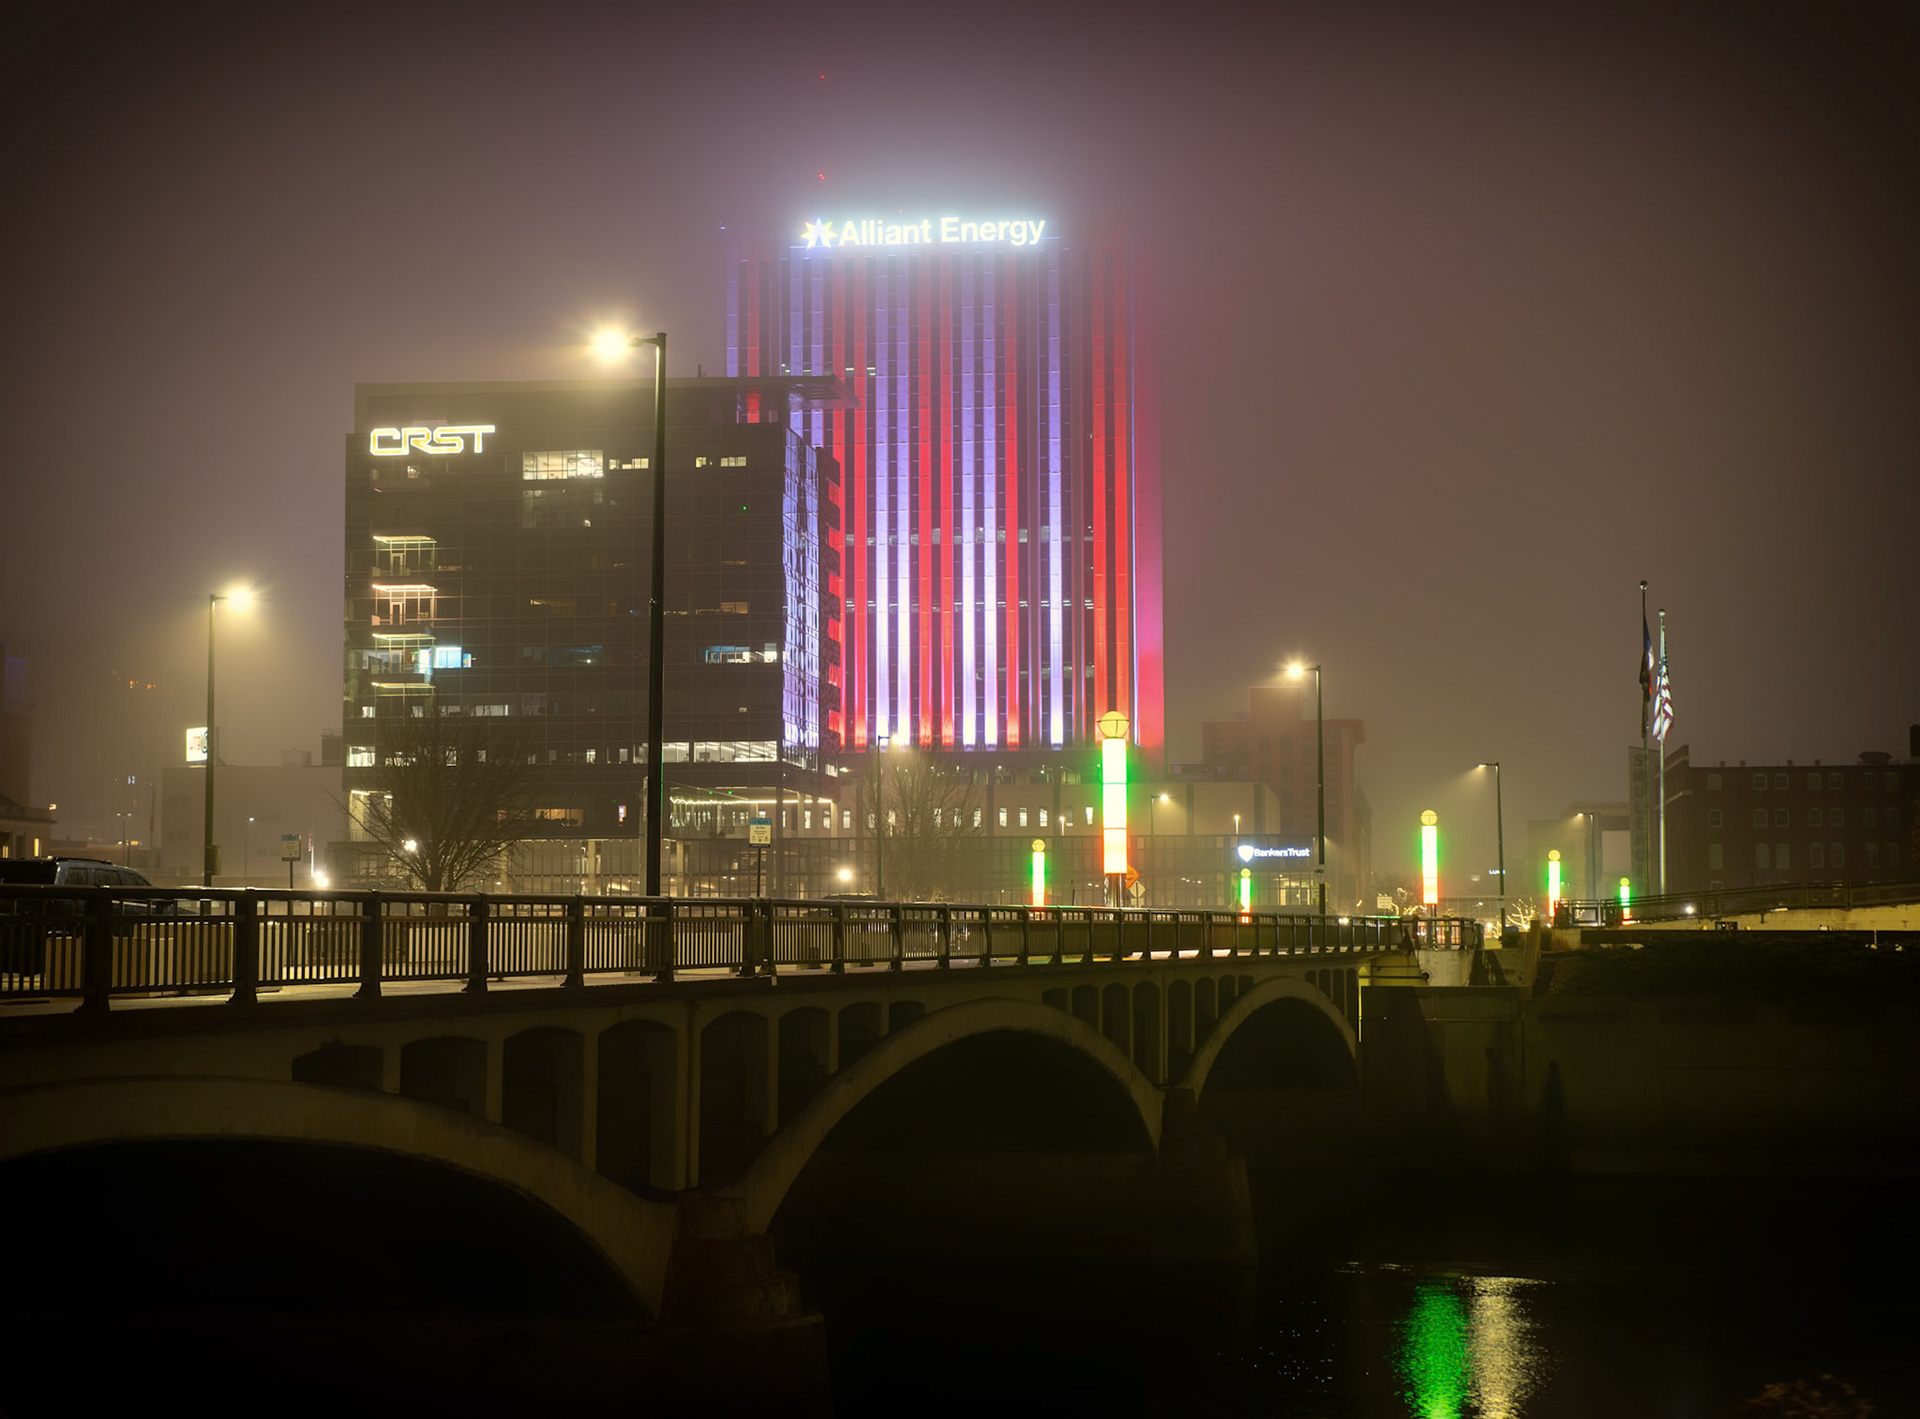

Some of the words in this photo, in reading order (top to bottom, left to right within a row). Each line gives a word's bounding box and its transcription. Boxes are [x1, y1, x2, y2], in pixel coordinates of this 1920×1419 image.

[839, 219, 931, 246] Alliant
[941, 217, 1046, 246] Energy
[369, 425, 496, 456] CRST
